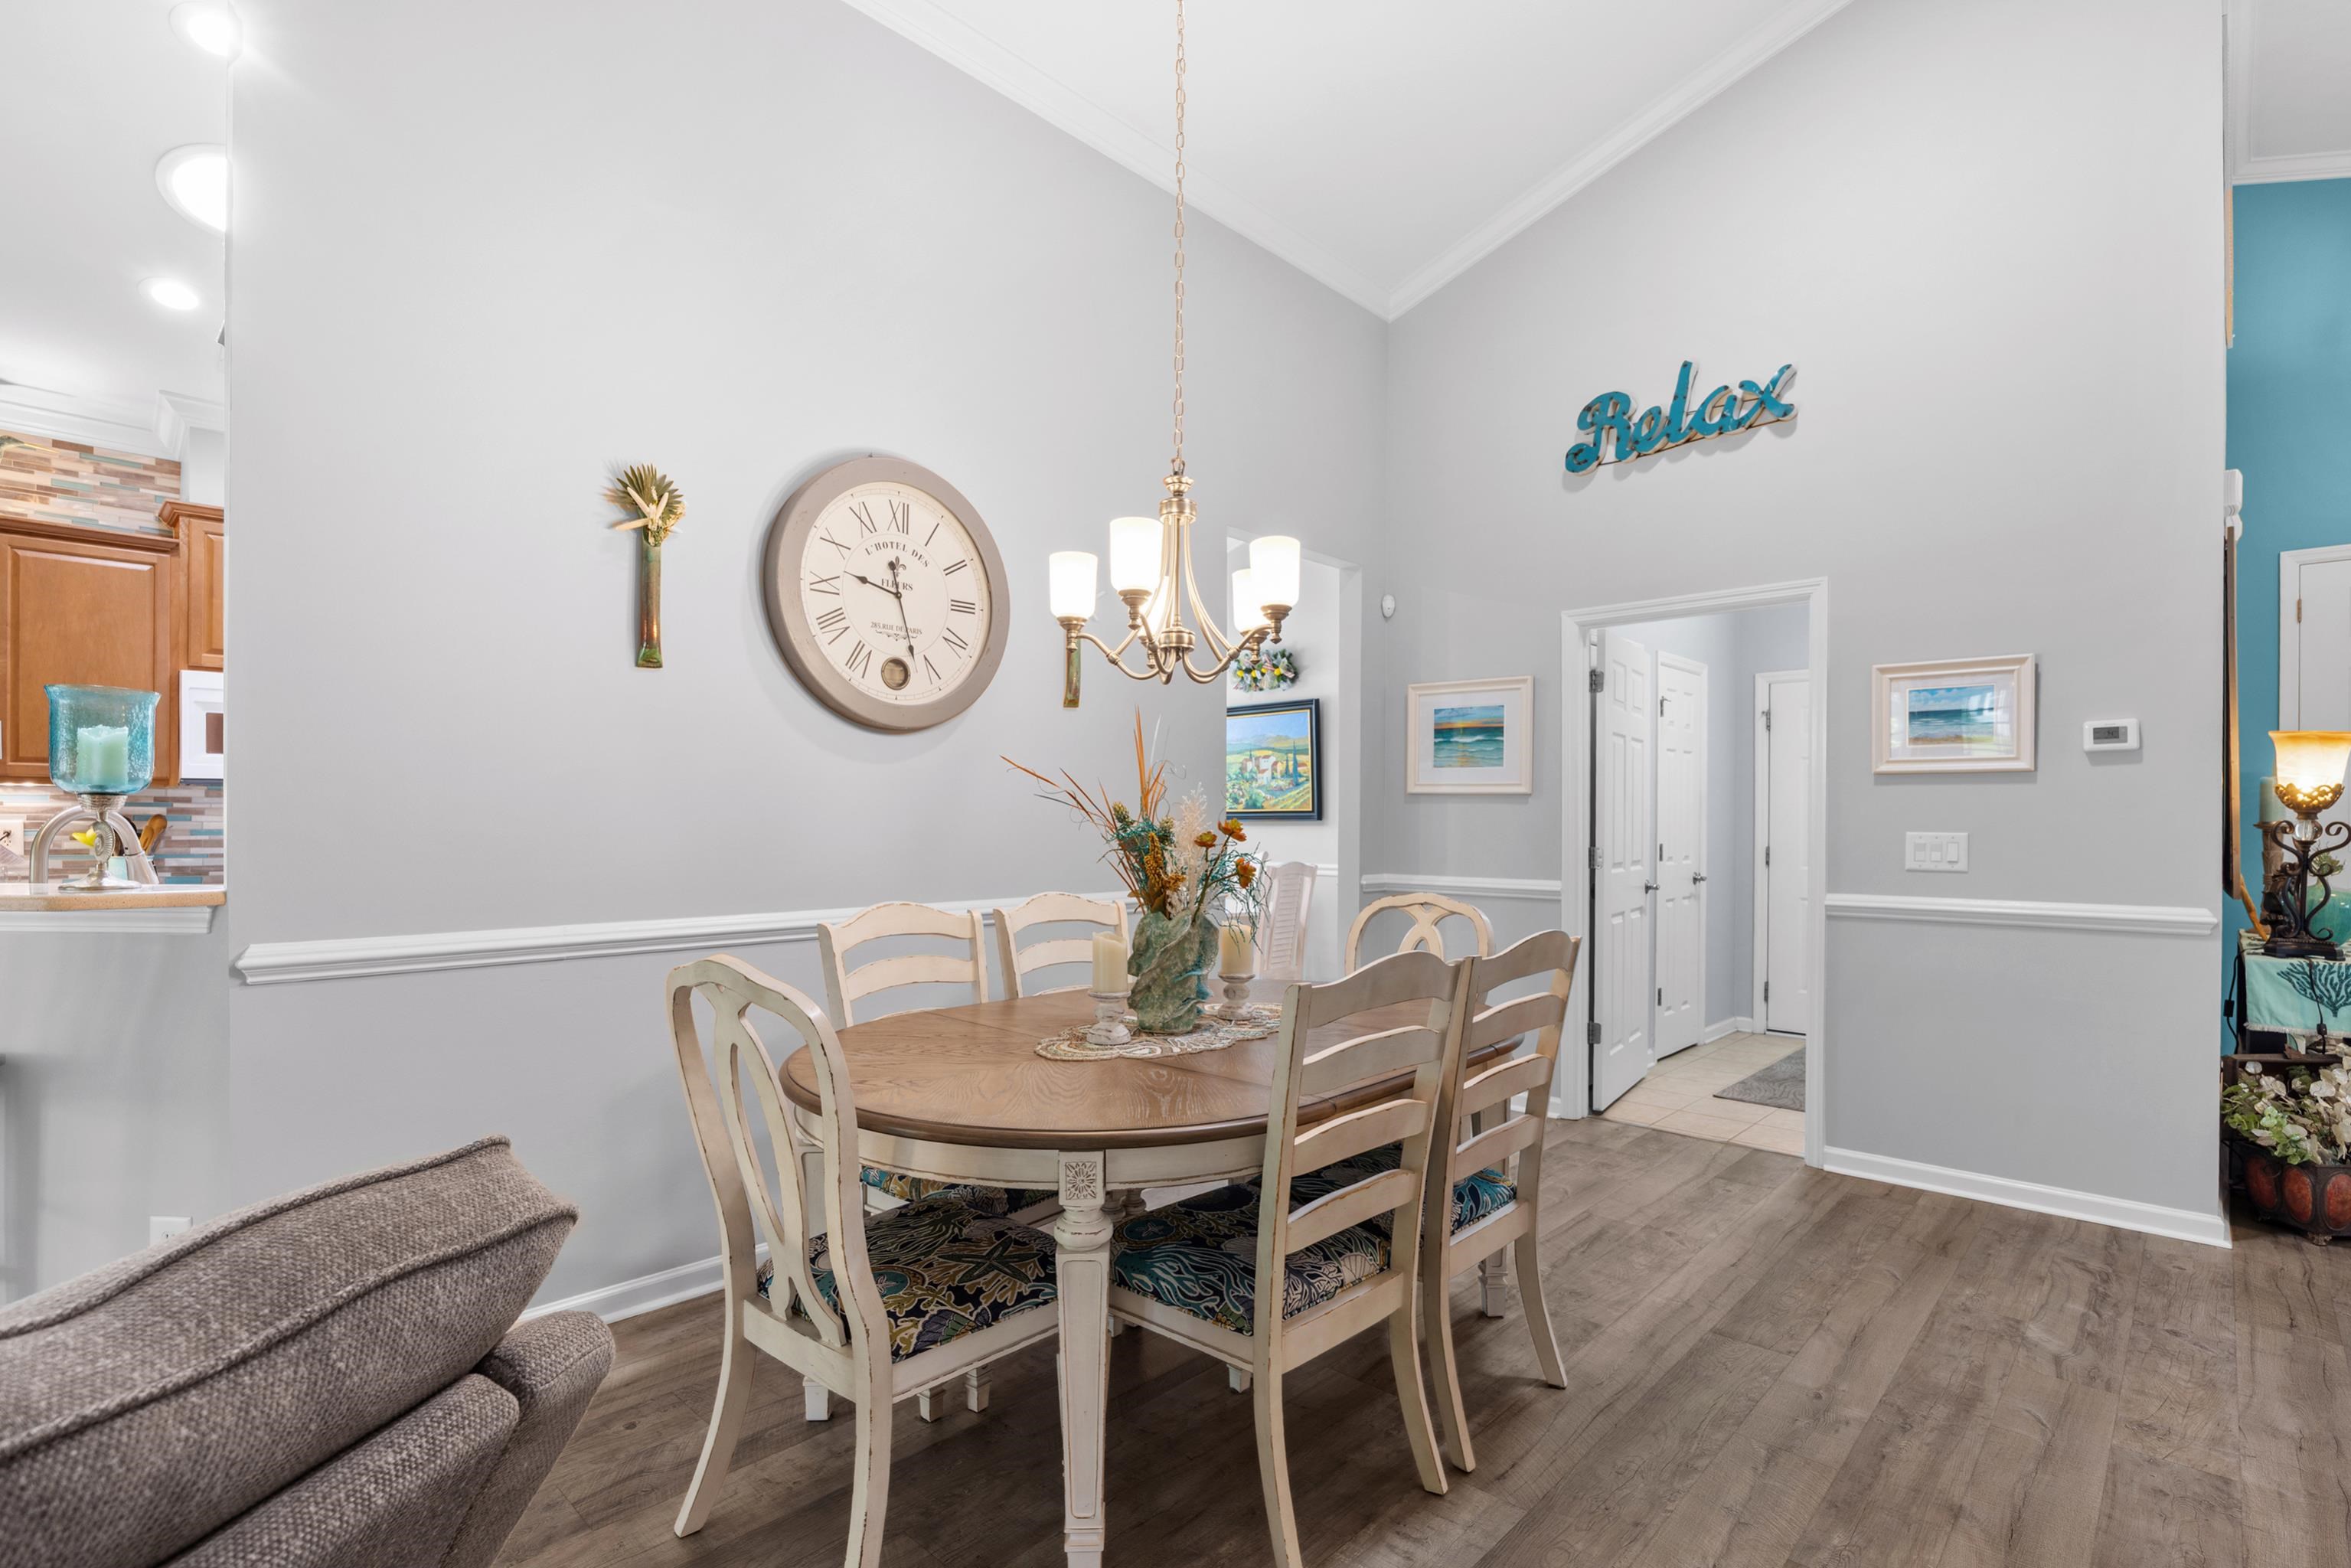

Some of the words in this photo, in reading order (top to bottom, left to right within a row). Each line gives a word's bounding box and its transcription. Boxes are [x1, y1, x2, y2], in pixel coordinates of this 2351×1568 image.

[1565, 360, 1798, 476] Relax
[848, 501, 877, 538] XI
[887, 499, 909, 535] XII
[819, 527, 851, 560] X
[865, 541, 907, 556] L'HOTEL
[911, 549, 930, 567] DES
[809, 570, 841, 596] IX
[881, 578, 913, 591] FLEURS
[942, 560, 968, 576] II
[950, 599, 976, 615] III
[816, 606, 851, 645] VIII
[845, 639, 872, 678] VII
[942, 627, 968, 660] IV
[923, 654, 942, 684] V
